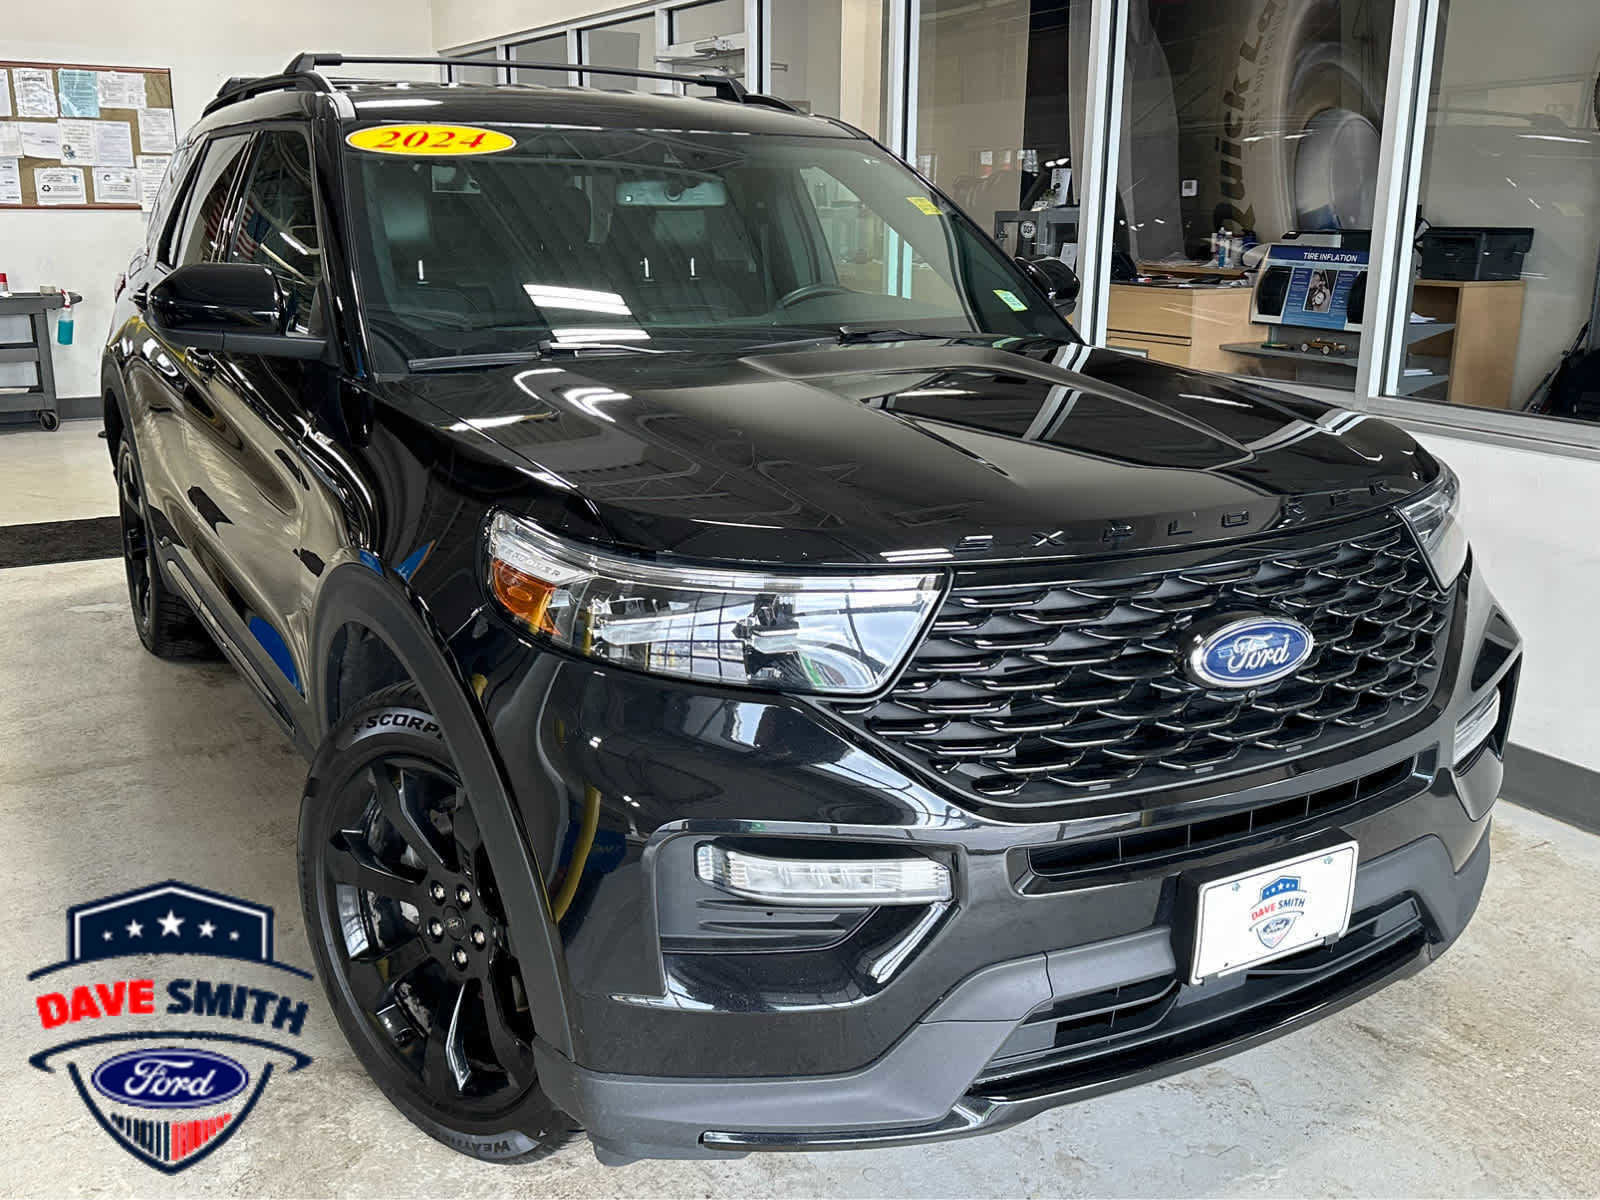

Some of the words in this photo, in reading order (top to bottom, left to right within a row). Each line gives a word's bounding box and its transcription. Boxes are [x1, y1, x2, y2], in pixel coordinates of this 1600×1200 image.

[374, 130, 487, 148] 2024
[1303, 252, 1319, 260] TIRE
[1320, 253, 1358, 262] INFLATION
[1227, 633, 1291, 673] Ford
[1251, 903, 1277, 921] DAVE
[1278, 897, 1306, 910] SMITH
